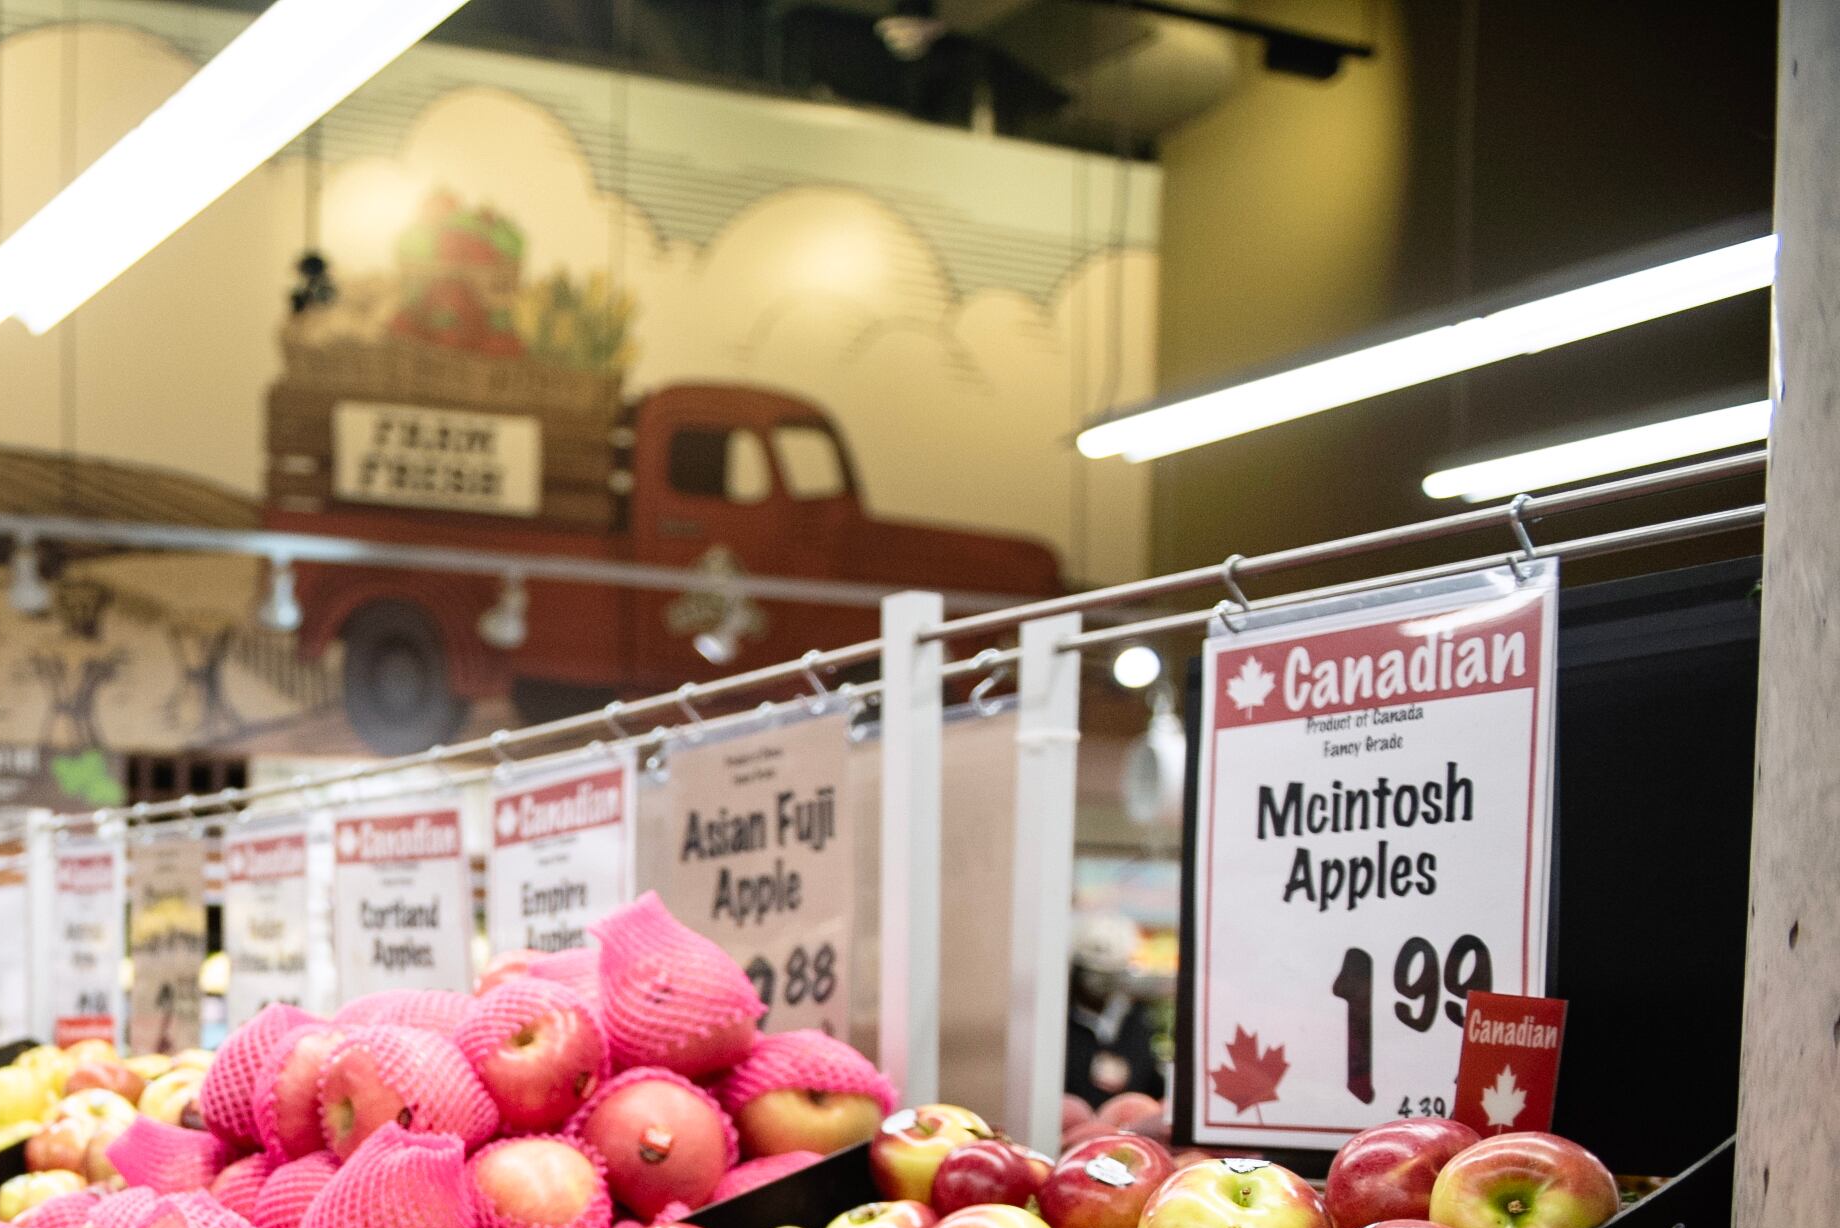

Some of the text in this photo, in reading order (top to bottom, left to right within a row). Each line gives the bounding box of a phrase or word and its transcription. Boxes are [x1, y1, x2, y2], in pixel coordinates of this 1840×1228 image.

[1282, 630, 1526, 712] Canadian
[1306, 704, 1425, 736] Product of Canada
[1323, 733, 1404, 758] Fancy Grade
[519, 784, 621, 835] Canadian
[1257, 761, 1473, 840] Mcintosh
[363, 817, 457, 857] Canadian
[679, 786, 837, 863] Asian Fuji
[522, 878, 588, 918] Empire
[712, 858, 803, 928] Apple
[1283, 840, 1437, 912] Apples
[361, 895, 441, 931] Cortland
[1468, 1008, 1559, 1050] Canadian
